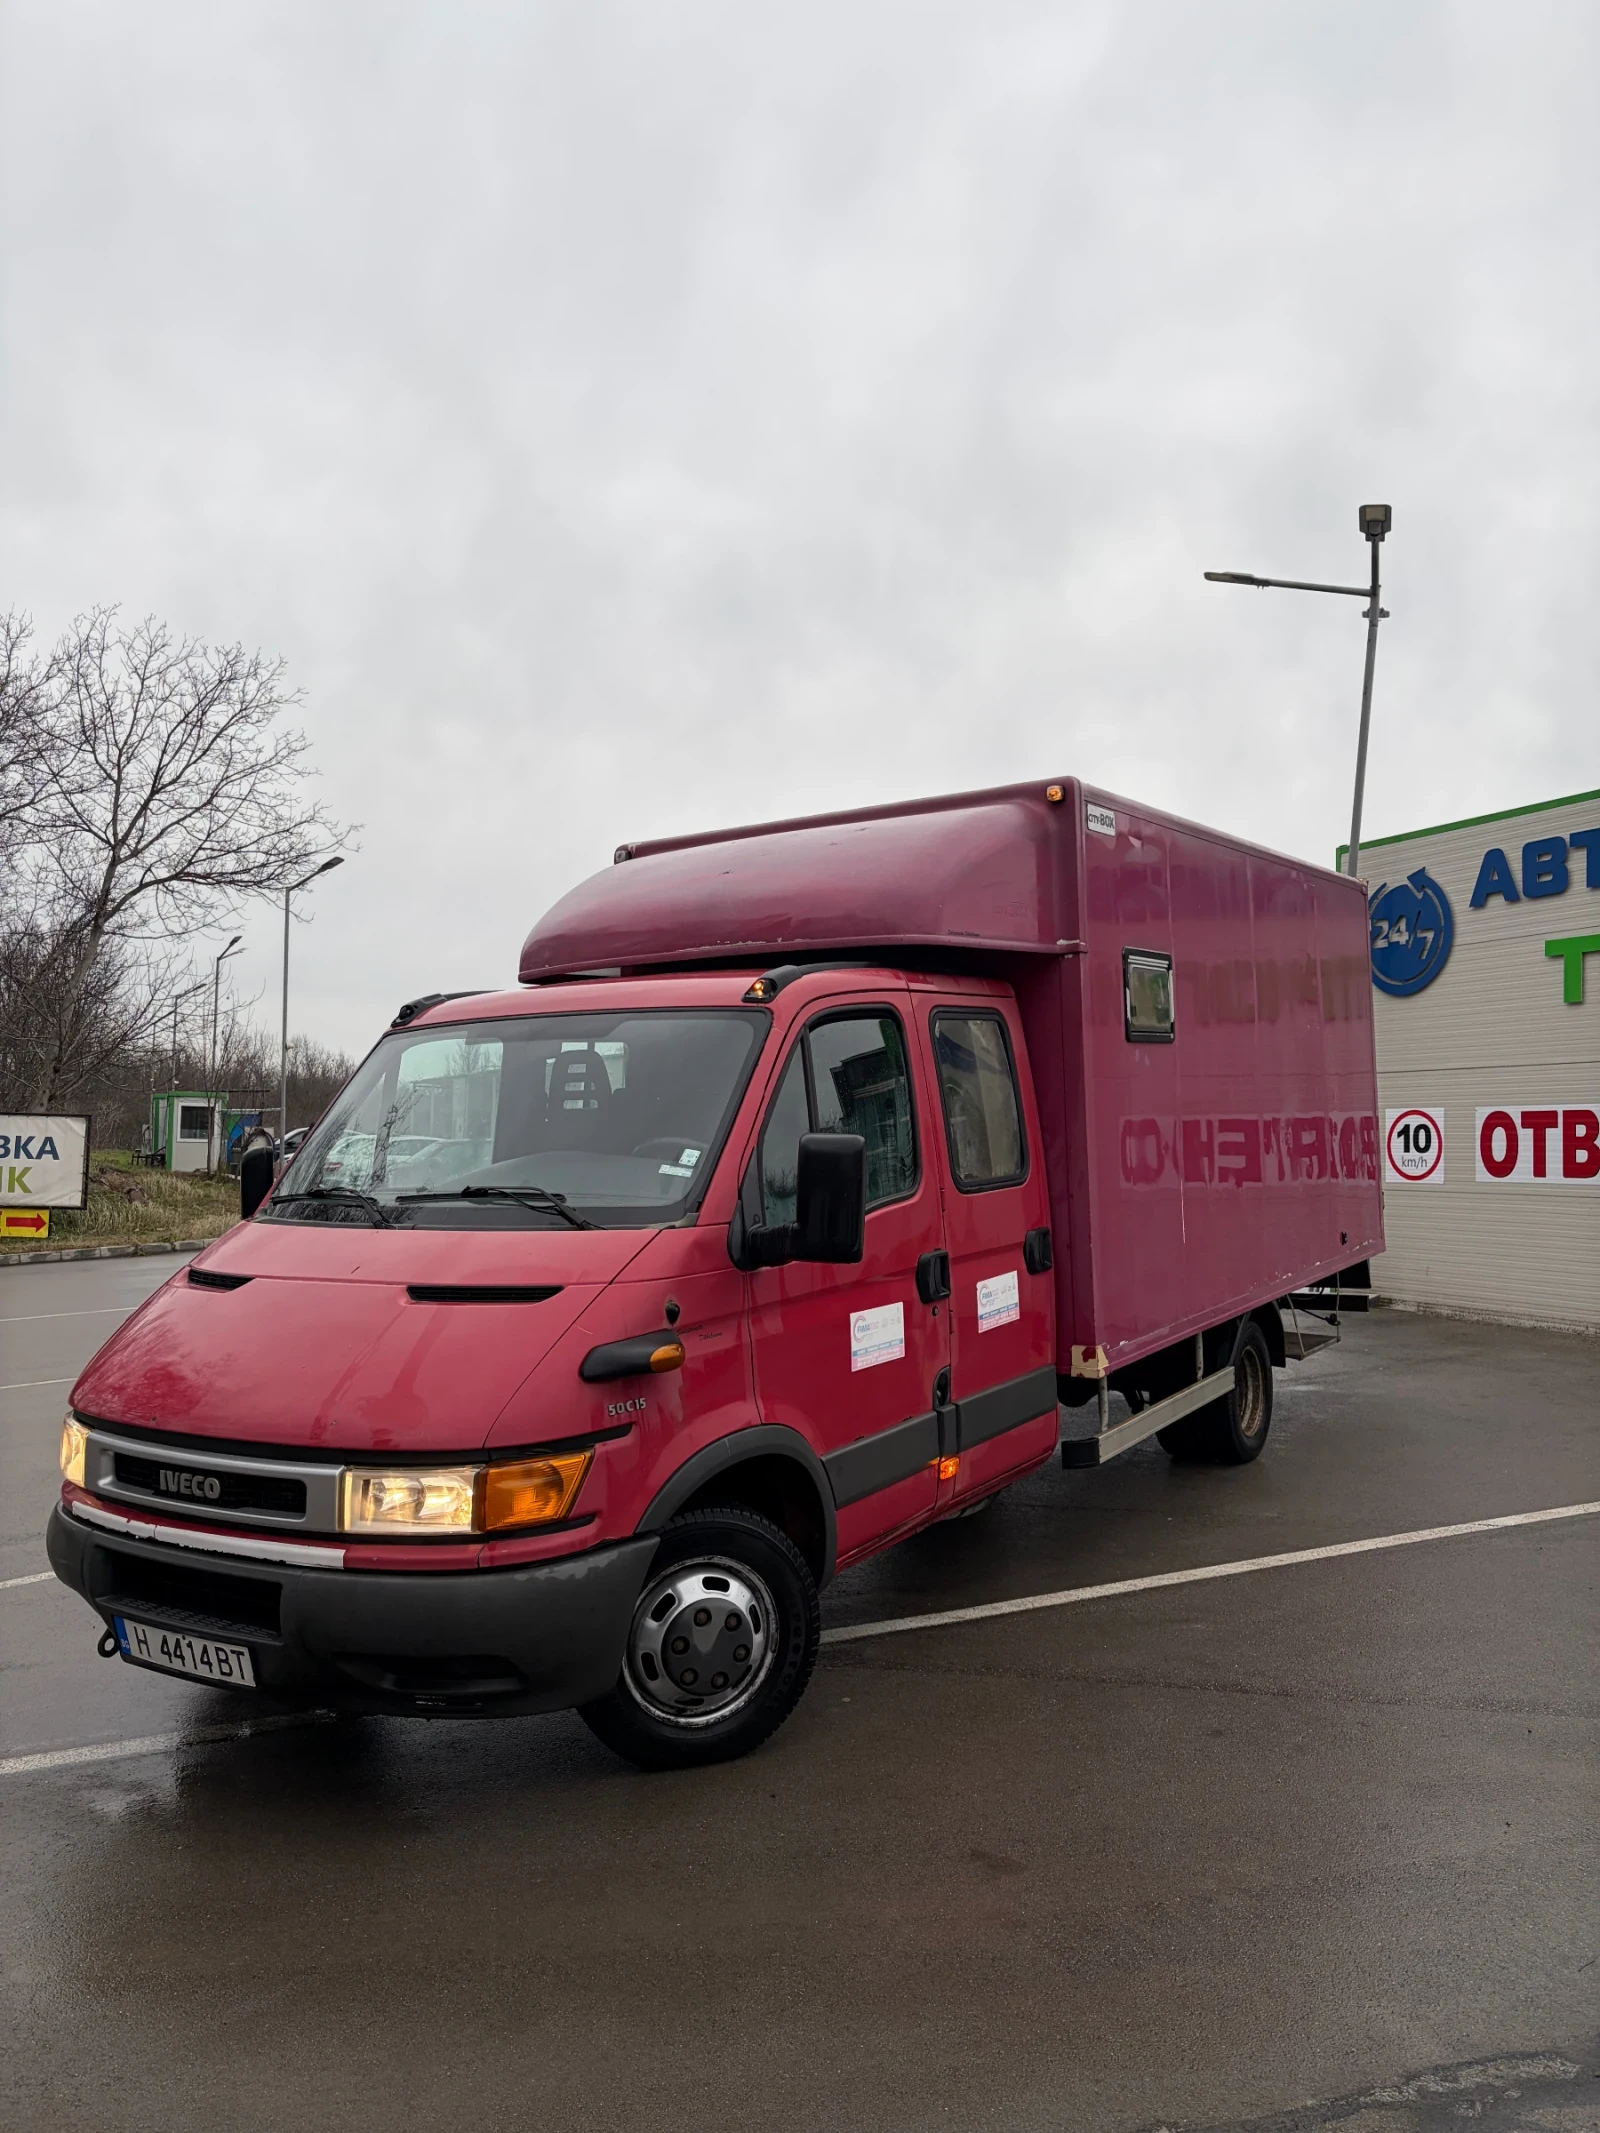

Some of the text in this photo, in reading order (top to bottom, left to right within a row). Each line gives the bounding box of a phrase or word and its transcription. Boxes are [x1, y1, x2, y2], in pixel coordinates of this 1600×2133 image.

[1372, 909, 1435, 960] 24/7
[1397, 1124, 1432, 1153] 10
[1480, 1110, 1600, 1178] ОТВ
[1401, 1156, 1428, 1169] km/h
[0, 1166, 33, 1193] К
[160, 1470, 220, 1499] IVECO
